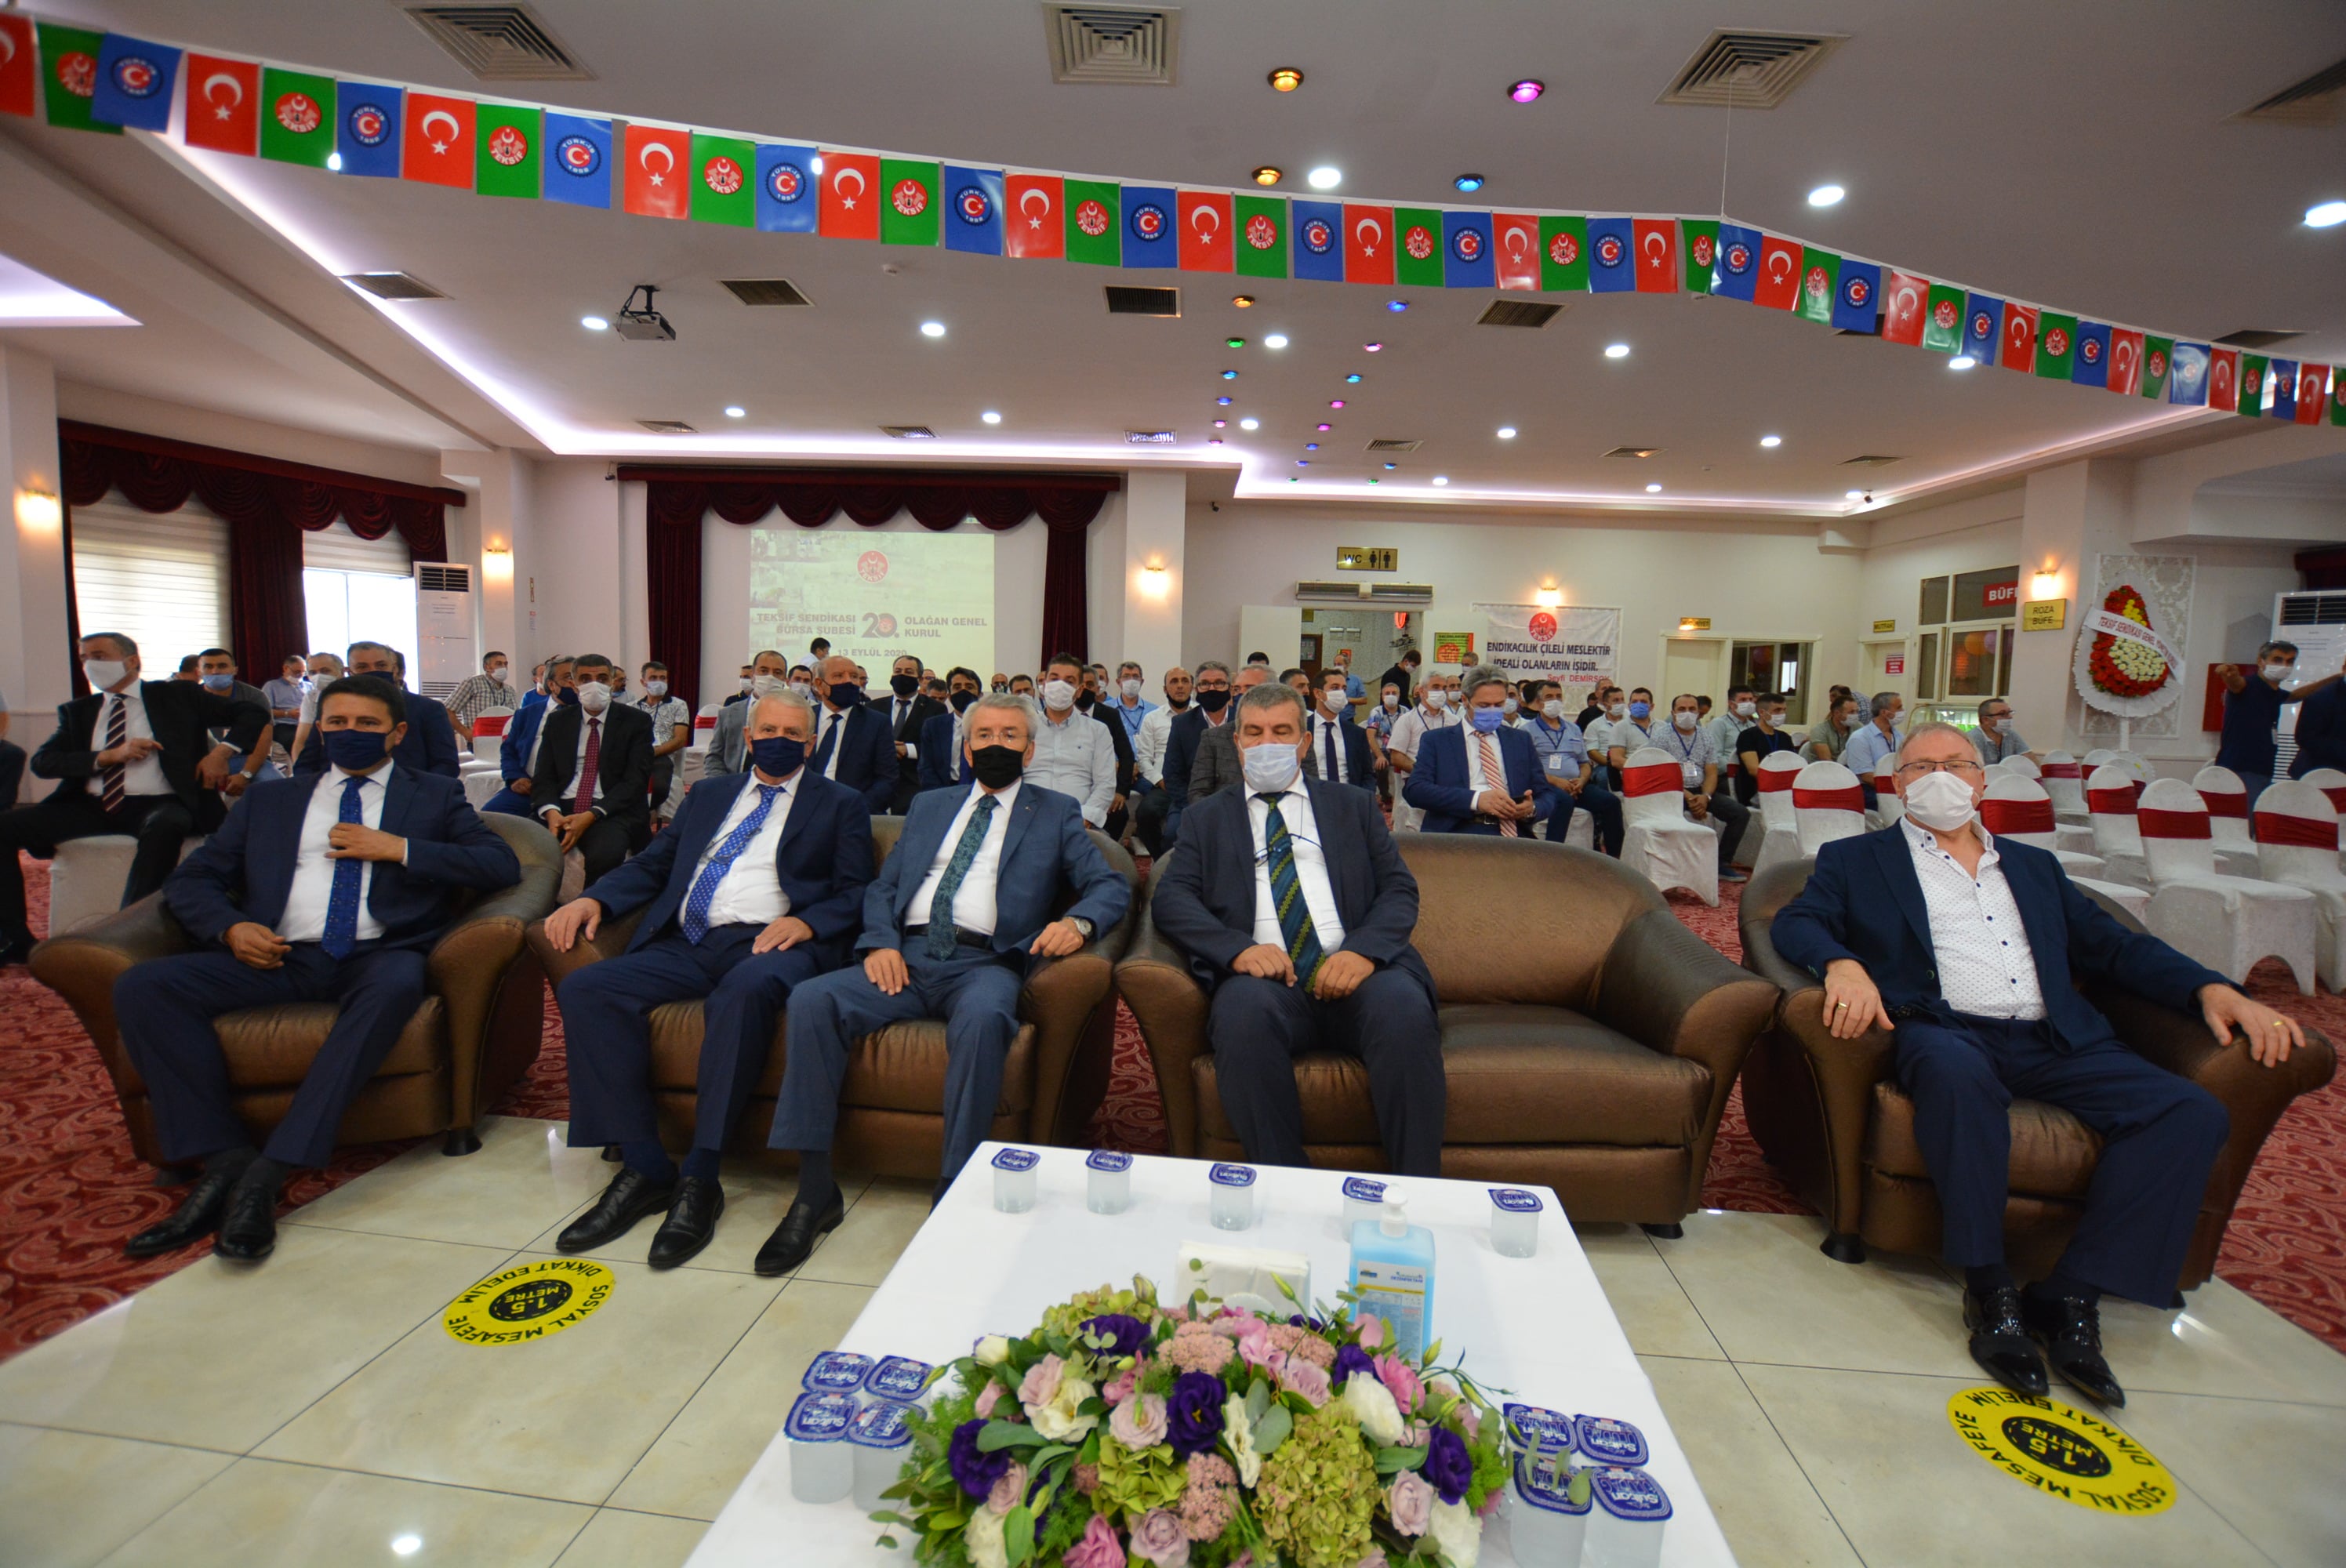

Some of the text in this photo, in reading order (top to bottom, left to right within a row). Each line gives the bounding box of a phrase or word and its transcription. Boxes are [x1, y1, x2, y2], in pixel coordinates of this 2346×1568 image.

[490, 147, 525, 166] TEKSİF
[706, 175, 740, 194] TEKSİF
[892, 199, 925, 216] TEKSİF
[1077, 219, 1106, 236] TEKSİF
[1344, 554, 1363, 564] WC
[2032, 605, 2054, 614] ROZA
[797, 612, 856, 623] SENDİKASI
[904, 615, 987, 627] OLAĞAN GENEL
[776, 625, 856, 637] BURSA ŞUBESİ
[904, 628, 942, 638] KURUL
[1530, 630, 1555, 641] TEKSİF
[837, 648, 848, 657] 13
[851, 647, 882, 658] EYLÜL
[1487, 640, 1611, 657] ENDİKACILIK ÇİLELİ MESLEKTİR
[1522, 659, 1571, 671] OLANLARIN
[1547, 674, 1566, 683] Seyfi
[458, 1261, 603, 1305] DİKKAT EDELİM
[505, 1286, 560, 1303] METRE
[448, 1284, 609, 1343] SOSYAL MESAFEYE
[510, 1298, 548, 1315] 1.5
[819, 1370, 859, 1384] Sultan
[881, 1377, 921, 1390] Sultan
[801, 1416, 846, 1427] Sultan
[1591, 1438, 1636, 1453] Sultan
[2021, 1422, 2093, 1459] METRE
[2060, 1409, 2155, 1467] DİKKAT
[2029, 1437, 2077, 1465] 1.5
[1955, 1411, 2166, 1511] SOSYAL MESAFEYE
[1534, 1480, 1568, 1497] ultan
[1611, 1491, 1659, 1504] Sultan
